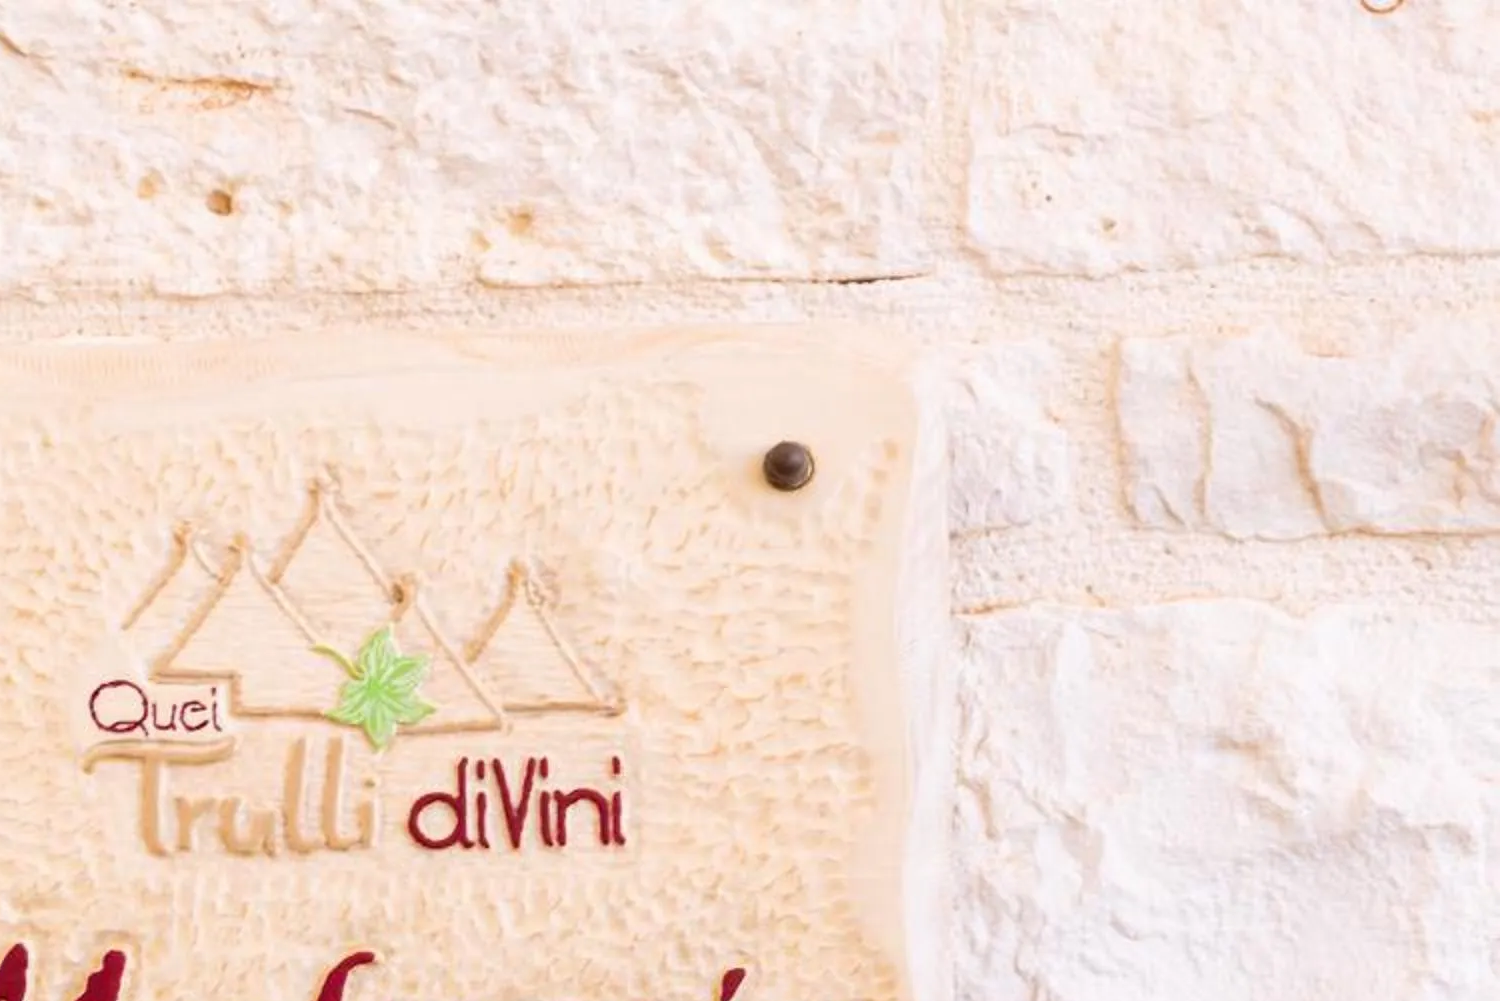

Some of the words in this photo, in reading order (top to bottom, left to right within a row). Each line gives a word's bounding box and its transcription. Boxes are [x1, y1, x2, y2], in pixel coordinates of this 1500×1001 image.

[89, 679, 225, 735] Quei
[82, 738, 377, 858] Trulli
[407, 756, 627, 850] diVini
